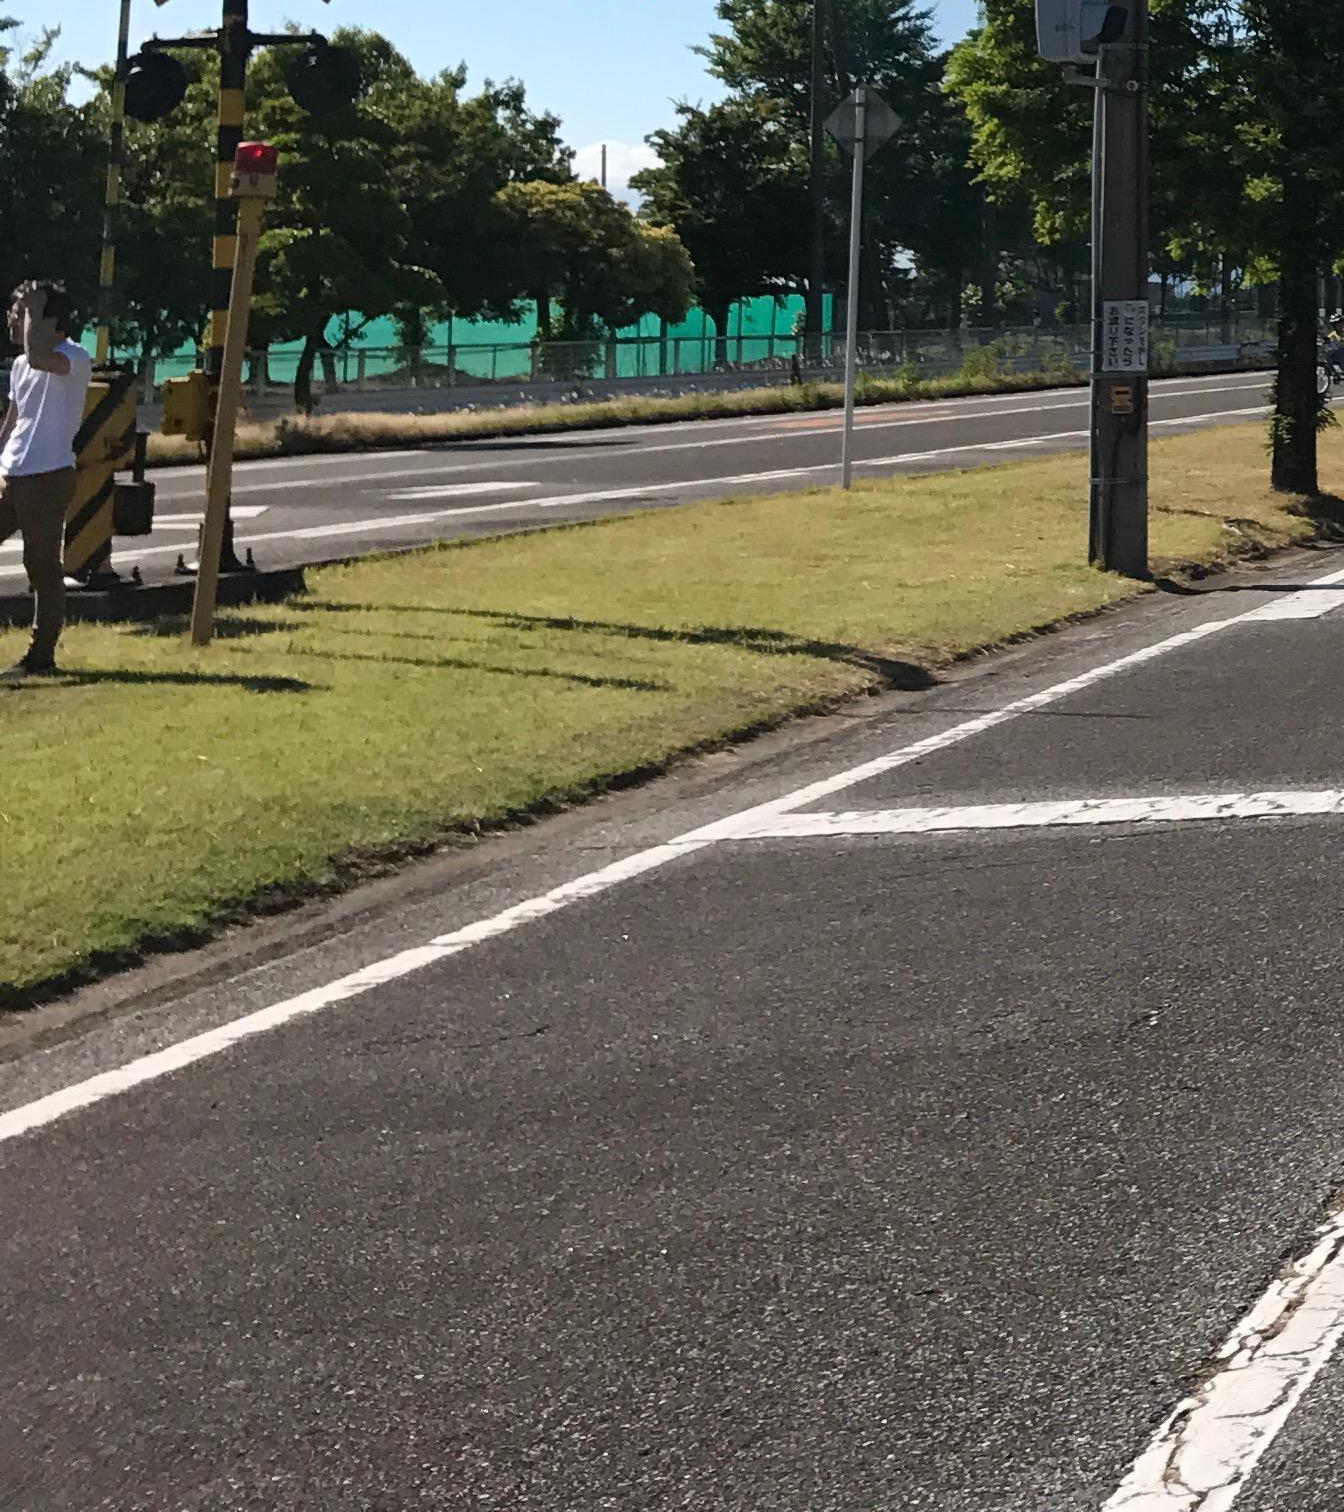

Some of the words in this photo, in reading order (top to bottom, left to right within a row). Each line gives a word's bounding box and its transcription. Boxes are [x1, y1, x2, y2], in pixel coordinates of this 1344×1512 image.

[1123, 303, 1135, 366] になったら
